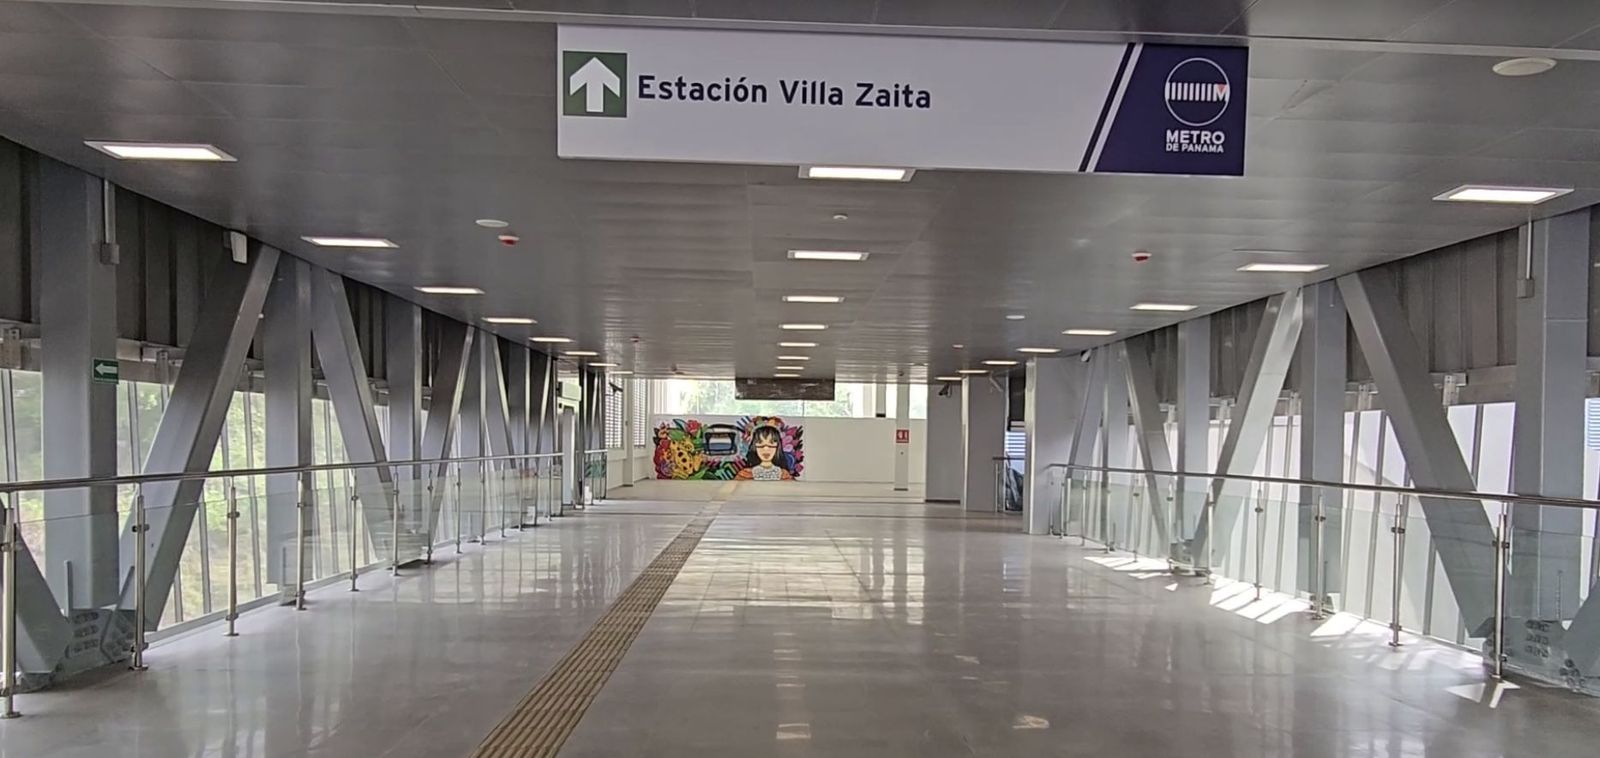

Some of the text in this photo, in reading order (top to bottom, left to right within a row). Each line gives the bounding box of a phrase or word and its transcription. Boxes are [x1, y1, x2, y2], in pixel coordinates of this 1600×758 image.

[638, 75, 931, 109] Estación Villa Zaita
[1166, 130, 1225, 144] METRO
[1166, 143, 1179, 152] DE
